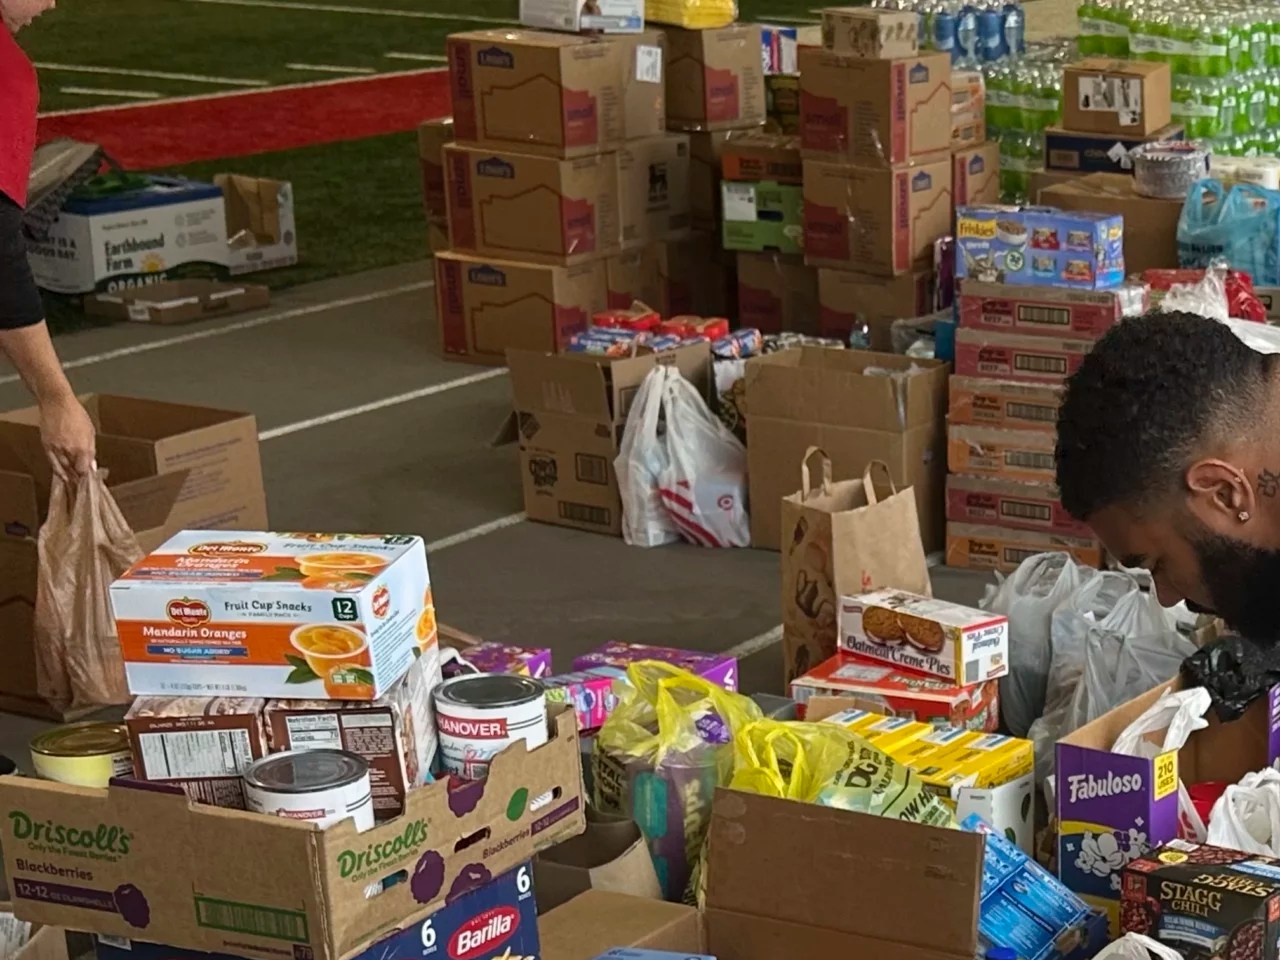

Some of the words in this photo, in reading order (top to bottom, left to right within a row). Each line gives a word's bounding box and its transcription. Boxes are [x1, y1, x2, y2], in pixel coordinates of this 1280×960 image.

[959, 220, 996, 237] Friskies
[104, 233, 165, 257] Earthbound
[106, 256, 134, 272] Farm
[169, 606, 185, 618] Del
[185, 607, 209, 619] Monte
[224, 600, 250, 611] Fruit
[251, 600, 273, 612] Cup
[275, 601, 312, 613] Snacks
[335, 601, 353, 614] 12
[143, 626, 198, 638] Mandarin
[200, 628, 247, 640] Oranges
[847, 635, 890, 663] Oatmeal
[889, 648, 925, 671] Creme
[925, 658, 951, 676] Pies
[287, 716, 317, 724] Nutrition
[318, 714, 338, 723] Facts
[1157, 761, 1174, 780] 210
[1067, 770, 1142, 804] Fabuloso
[1157, 776, 1175, 791] USES
[287, 810, 325, 820] HANOVER
[8, 809, 132, 855] Driscoll's
[28, 841, 45, 853] Only
[336, 818, 429, 879] Driscoll's
[482, 828, 531, 860] Blackberries
[15, 858, 94, 882] Blackberries
[517, 866, 530, 893] 6
[16, 882, 49, 900] 12-12
[1192, 874, 1276, 898] STAGG
[1159, 881, 1224, 913] STAGG
[1171, 899, 1209, 918] CHILI
[421, 919, 437, 947] 6
[456, 915, 512, 956] Barilla
